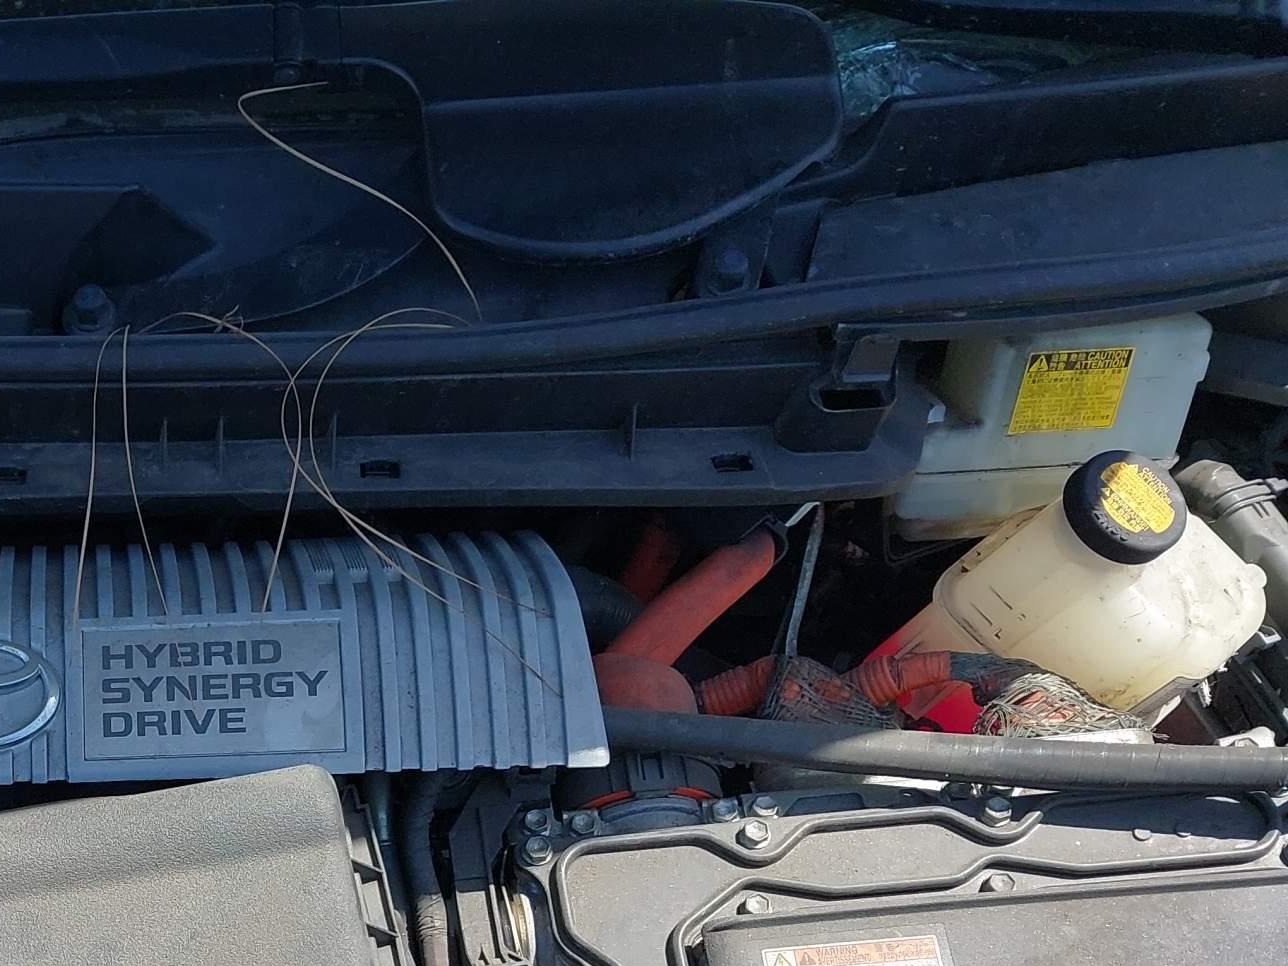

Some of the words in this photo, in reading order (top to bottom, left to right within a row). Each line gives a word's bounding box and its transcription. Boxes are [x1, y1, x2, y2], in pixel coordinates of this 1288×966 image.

[1074, 359, 1126, 370] ATTENTION
[1087, 350, 1130, 361] CAUTION
[1138, 472, 1172, 505] ATTENTION
[1142, 467, 1170, 493] CAUTION
[101, 639, 282, 670] HYBRID
[101, 670, 329, 704] SYNERGY
[102, 707, 247, 738] DRIVE
[815, 945, 858, 957] WARNING
